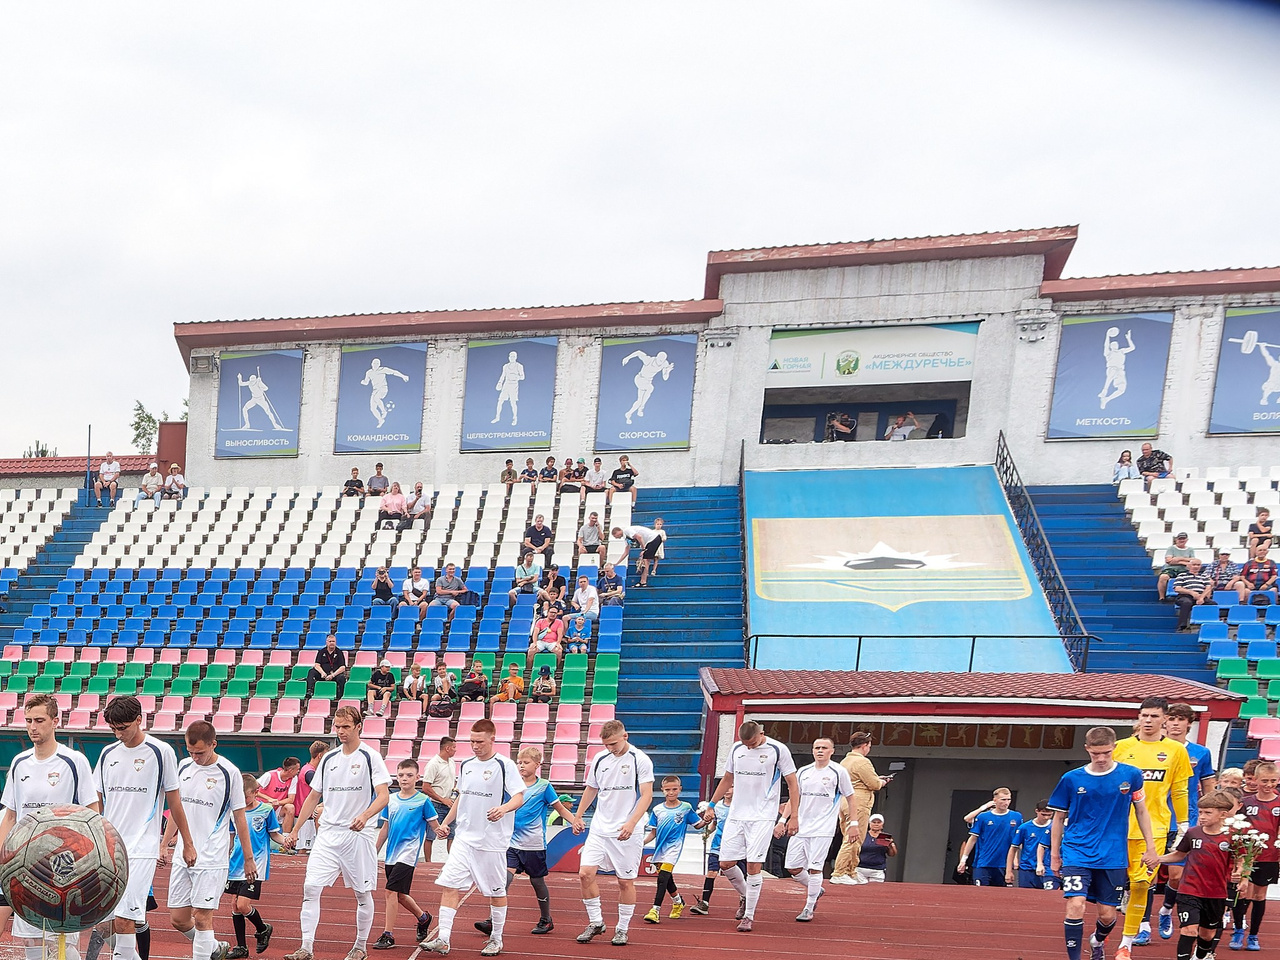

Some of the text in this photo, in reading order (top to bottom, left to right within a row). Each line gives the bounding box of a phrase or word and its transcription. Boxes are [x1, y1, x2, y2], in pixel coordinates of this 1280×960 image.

[864, 357, 972, 371] «МЕЖДУРЕЧЬЕ»
[1075, 417, 1132, 426] МЕТКОСТЬ
[347, 433, 410, 442] КОМАНДНОСТЬ
[466, 430, 547, 440] ЦЕЛЕУСТРЕМЛЕННОСТЬ
[618, 430, 667, 439] СКОРОСТЬ
[225, 438, 290, 447] ВЫНОСЛИВОСТЬ
[1246, 805, 1259, 816] 20
[1191, 838, 1203, 849] 19
[1063, 876, 1083, 891] 33
[1178, 911, 1190, 923] 19
